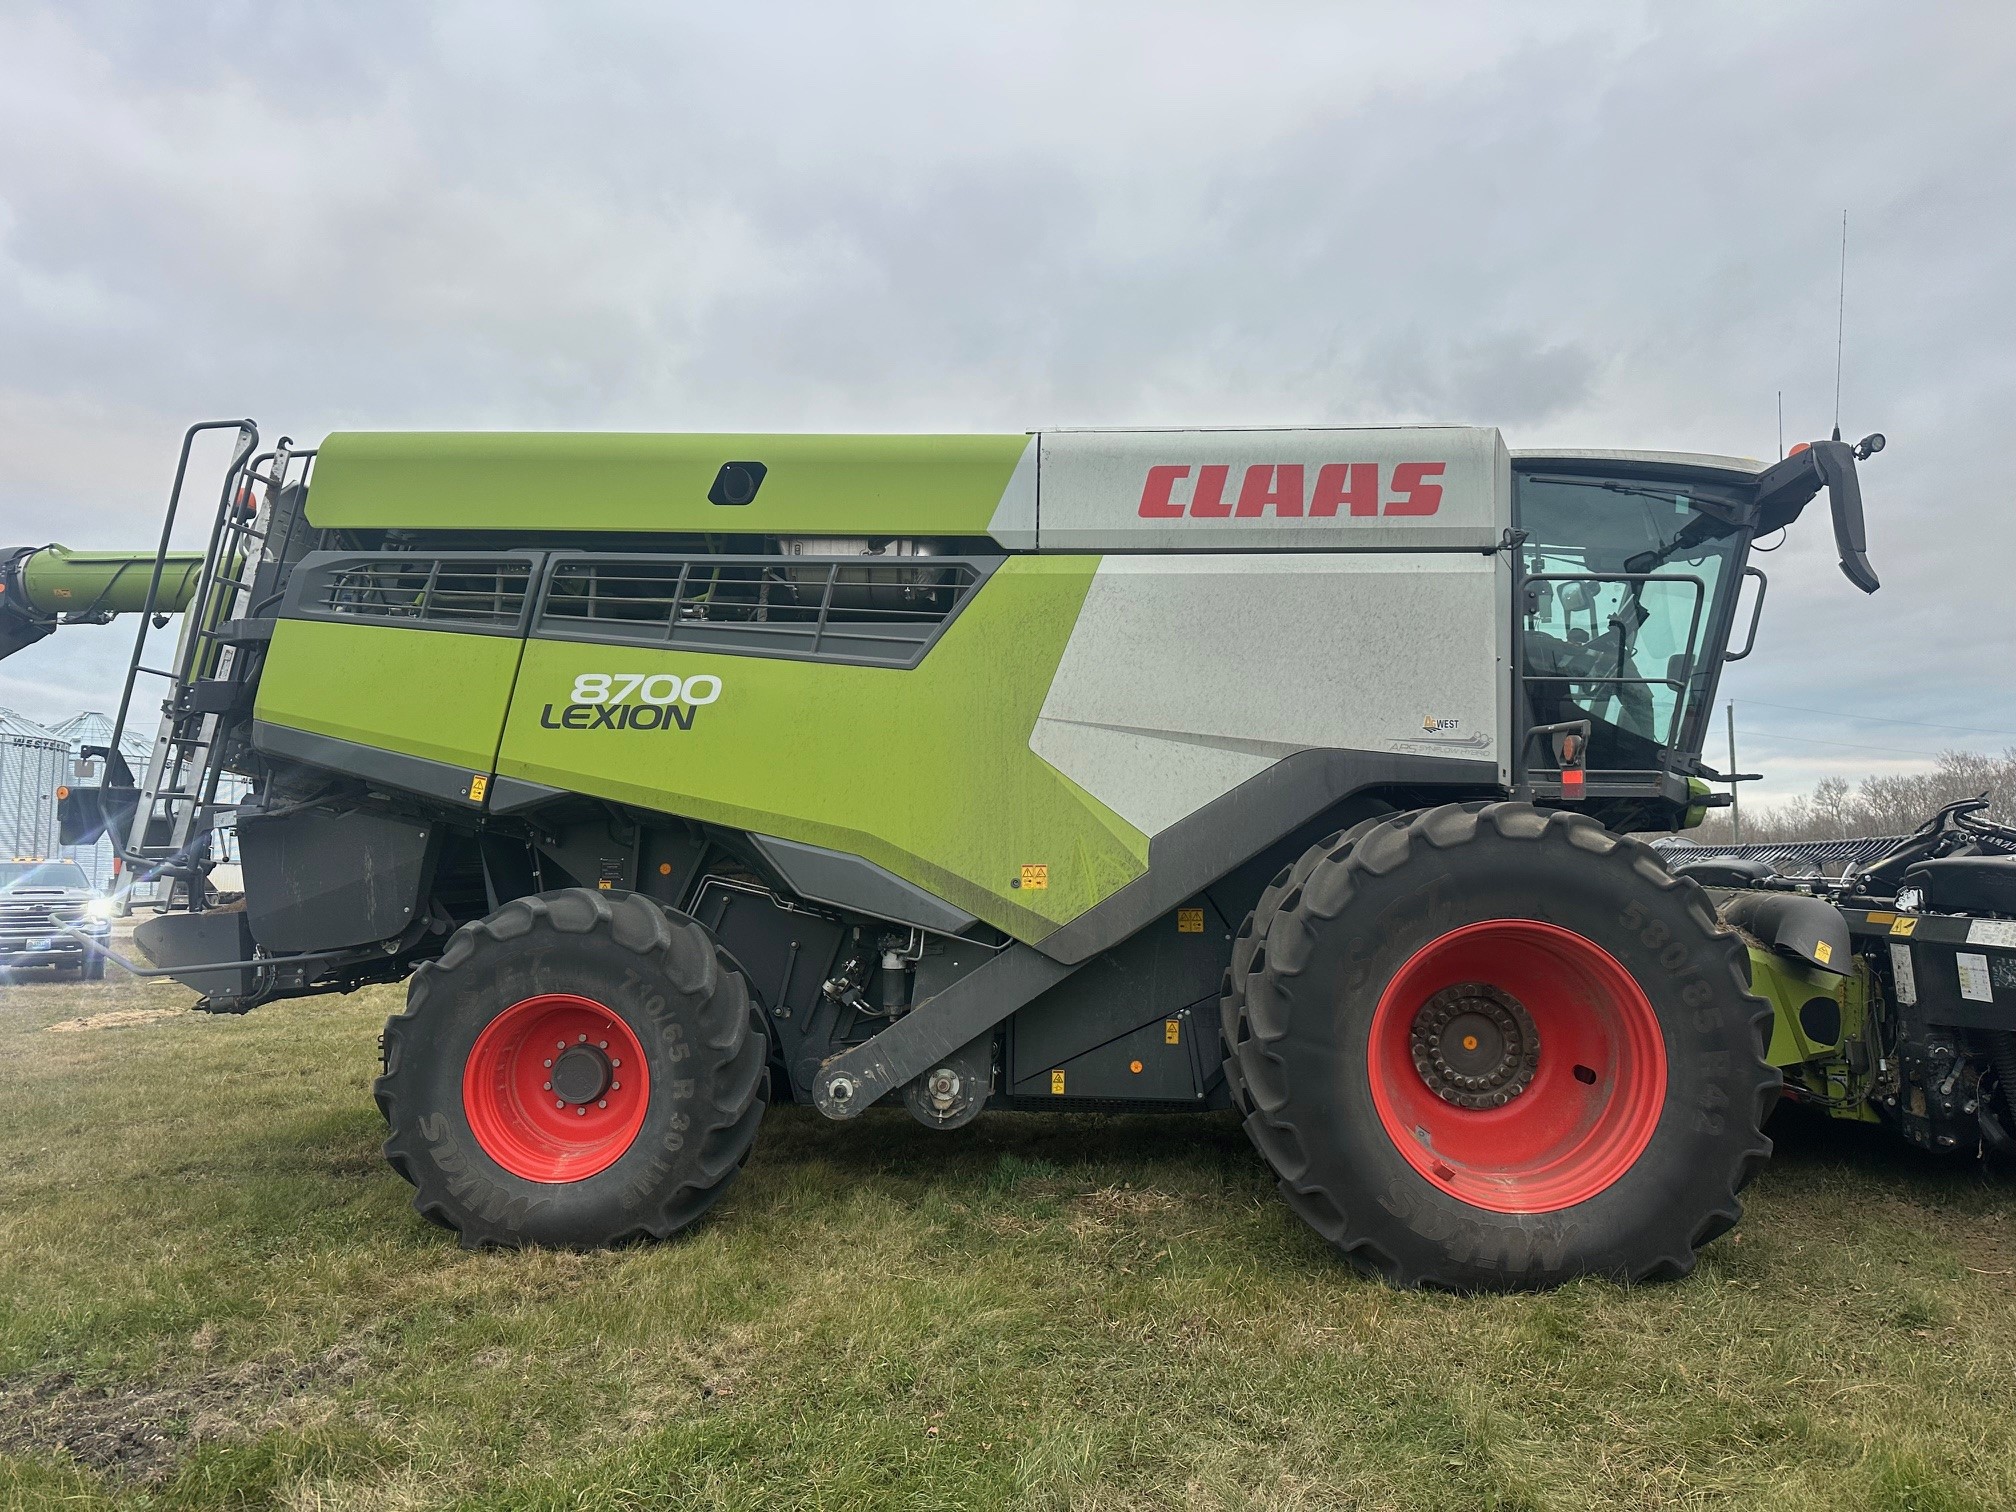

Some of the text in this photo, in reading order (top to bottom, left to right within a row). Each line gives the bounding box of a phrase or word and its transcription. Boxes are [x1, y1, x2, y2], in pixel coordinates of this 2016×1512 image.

[1138, 462, 1446, 518] CLAAS
[570, 673, 722, 705] 8700
[540, 703, 697, 730] LEXION
[1389, 742, 1418, 753] APS
[620, 967, 691, 1063] 710/65
